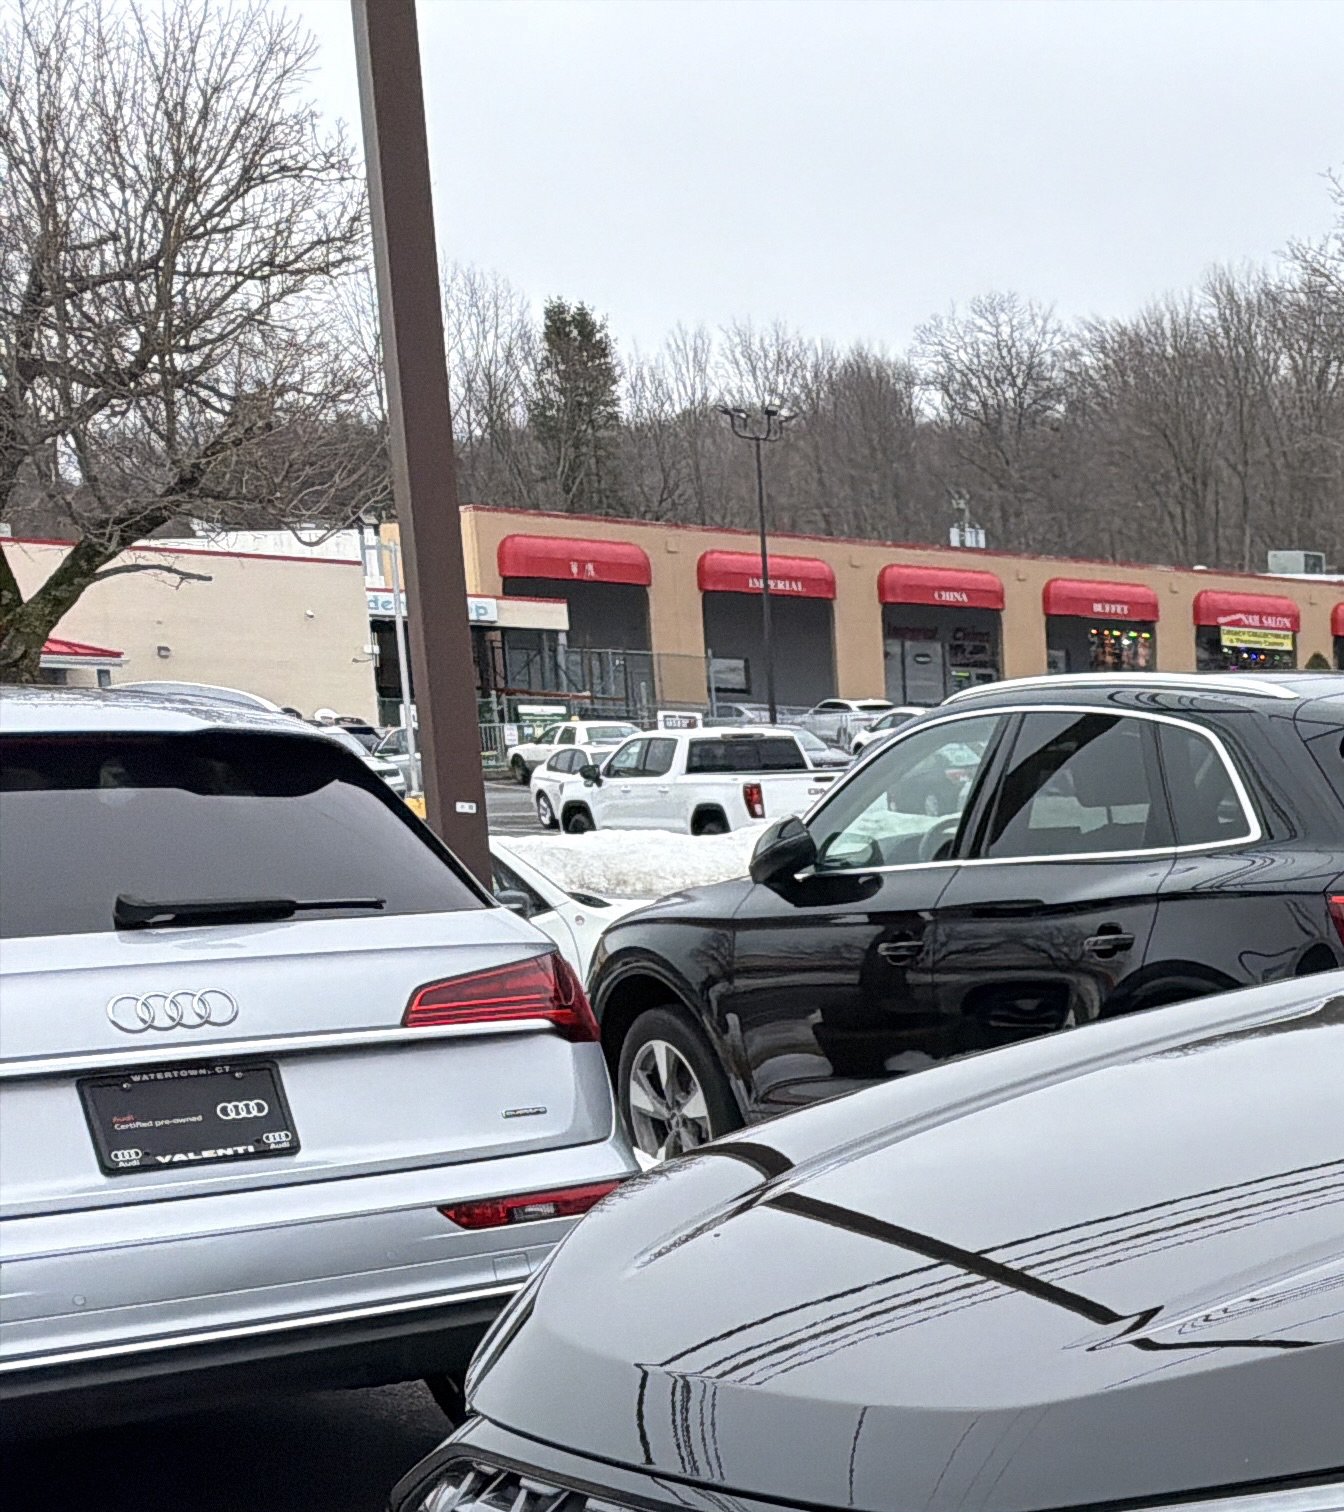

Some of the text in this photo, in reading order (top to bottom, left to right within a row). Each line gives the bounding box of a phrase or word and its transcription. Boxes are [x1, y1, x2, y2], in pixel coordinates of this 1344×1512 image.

[214, 1065, 231, 1075] CT
[113, 1114, 203, 1131] Certified pre-owned
[269, 1141, 291, 1149] Audi
[154, 1144, 256, 1164] VALENTI
[117, 1159, 141, 1168] Audi
